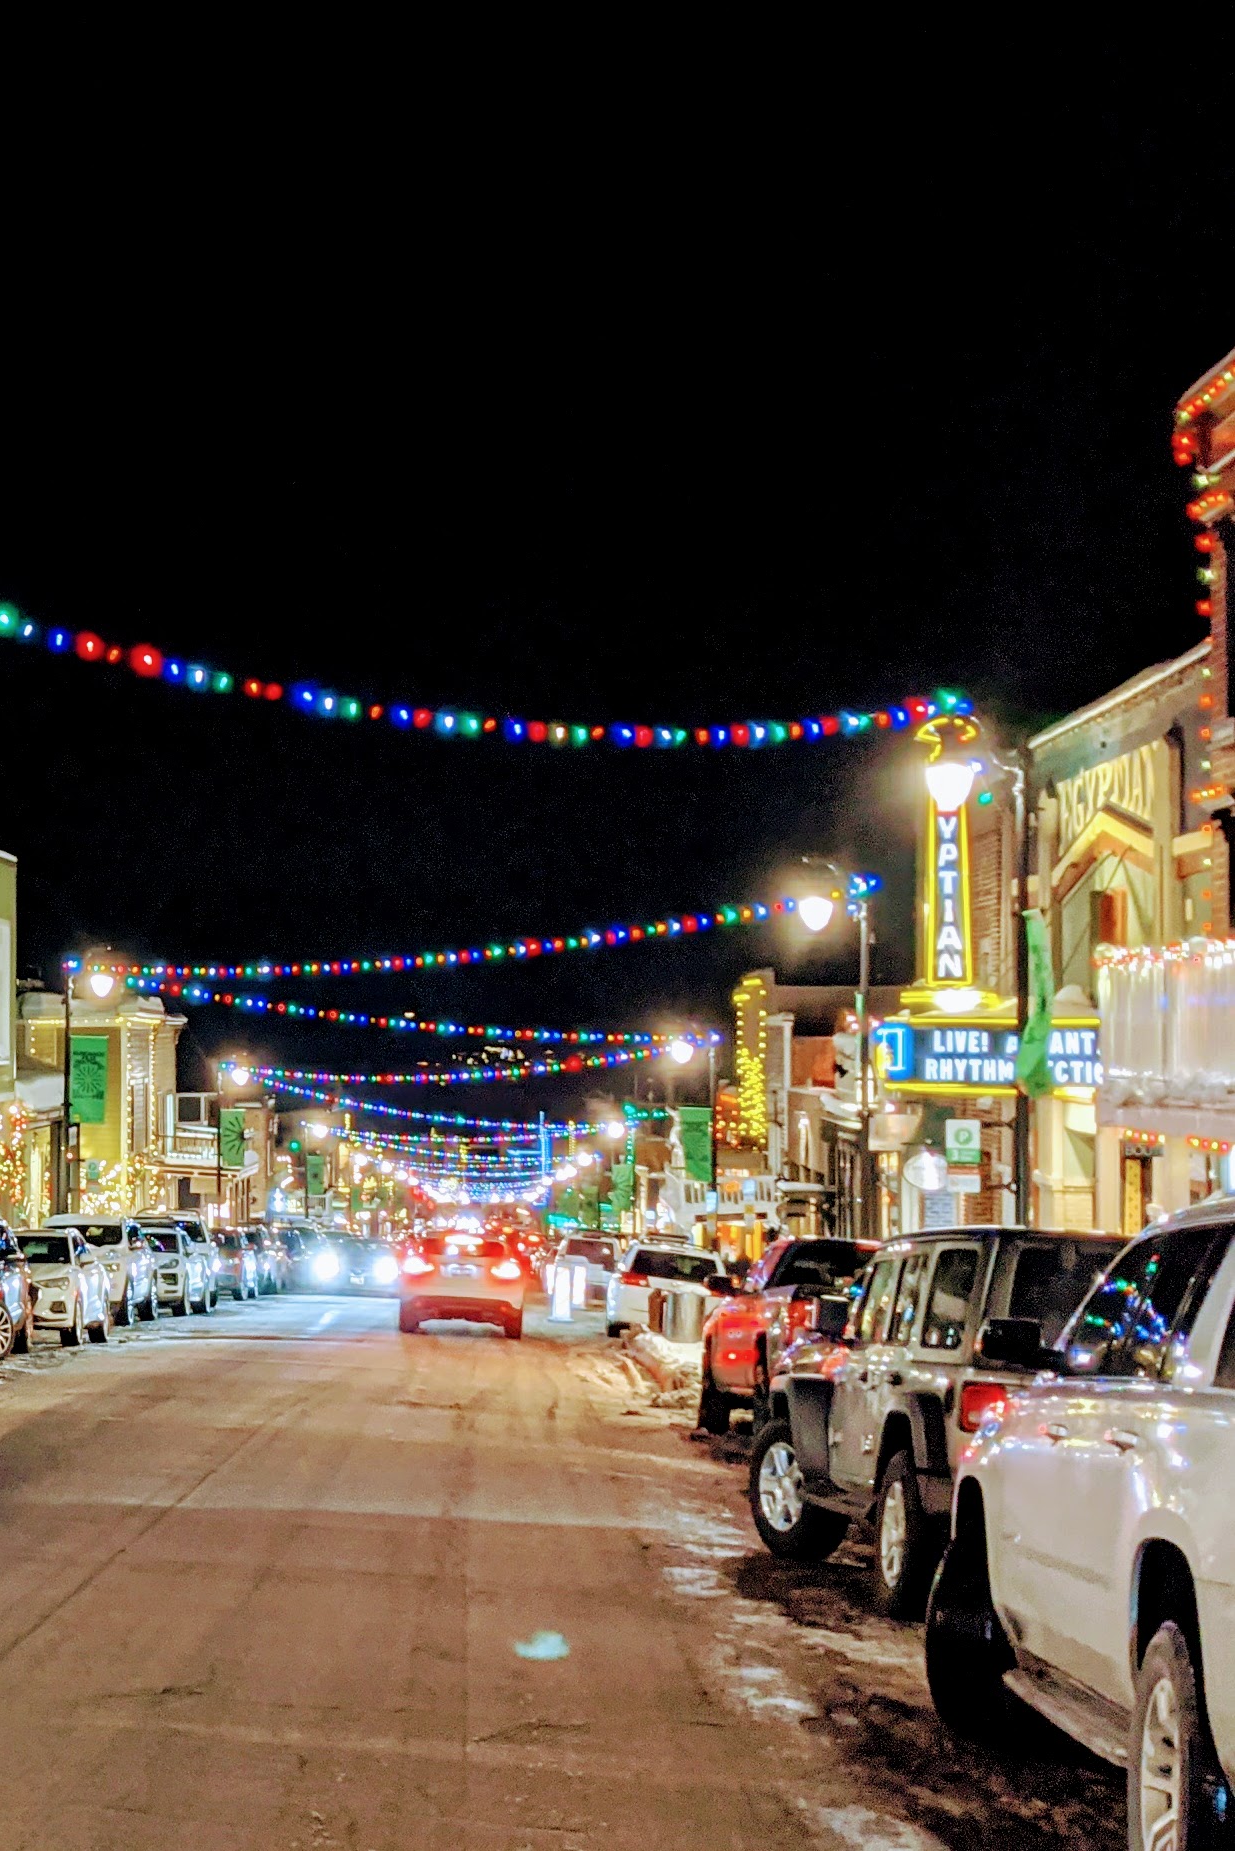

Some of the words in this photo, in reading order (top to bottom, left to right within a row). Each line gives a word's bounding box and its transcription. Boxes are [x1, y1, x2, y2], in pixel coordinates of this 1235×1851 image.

[937, 816, 963, 978] YPTIAN
[933, 1030, 989, 1053] LIVE!
[925, 1058, 1014, 1082] RHYTHM
